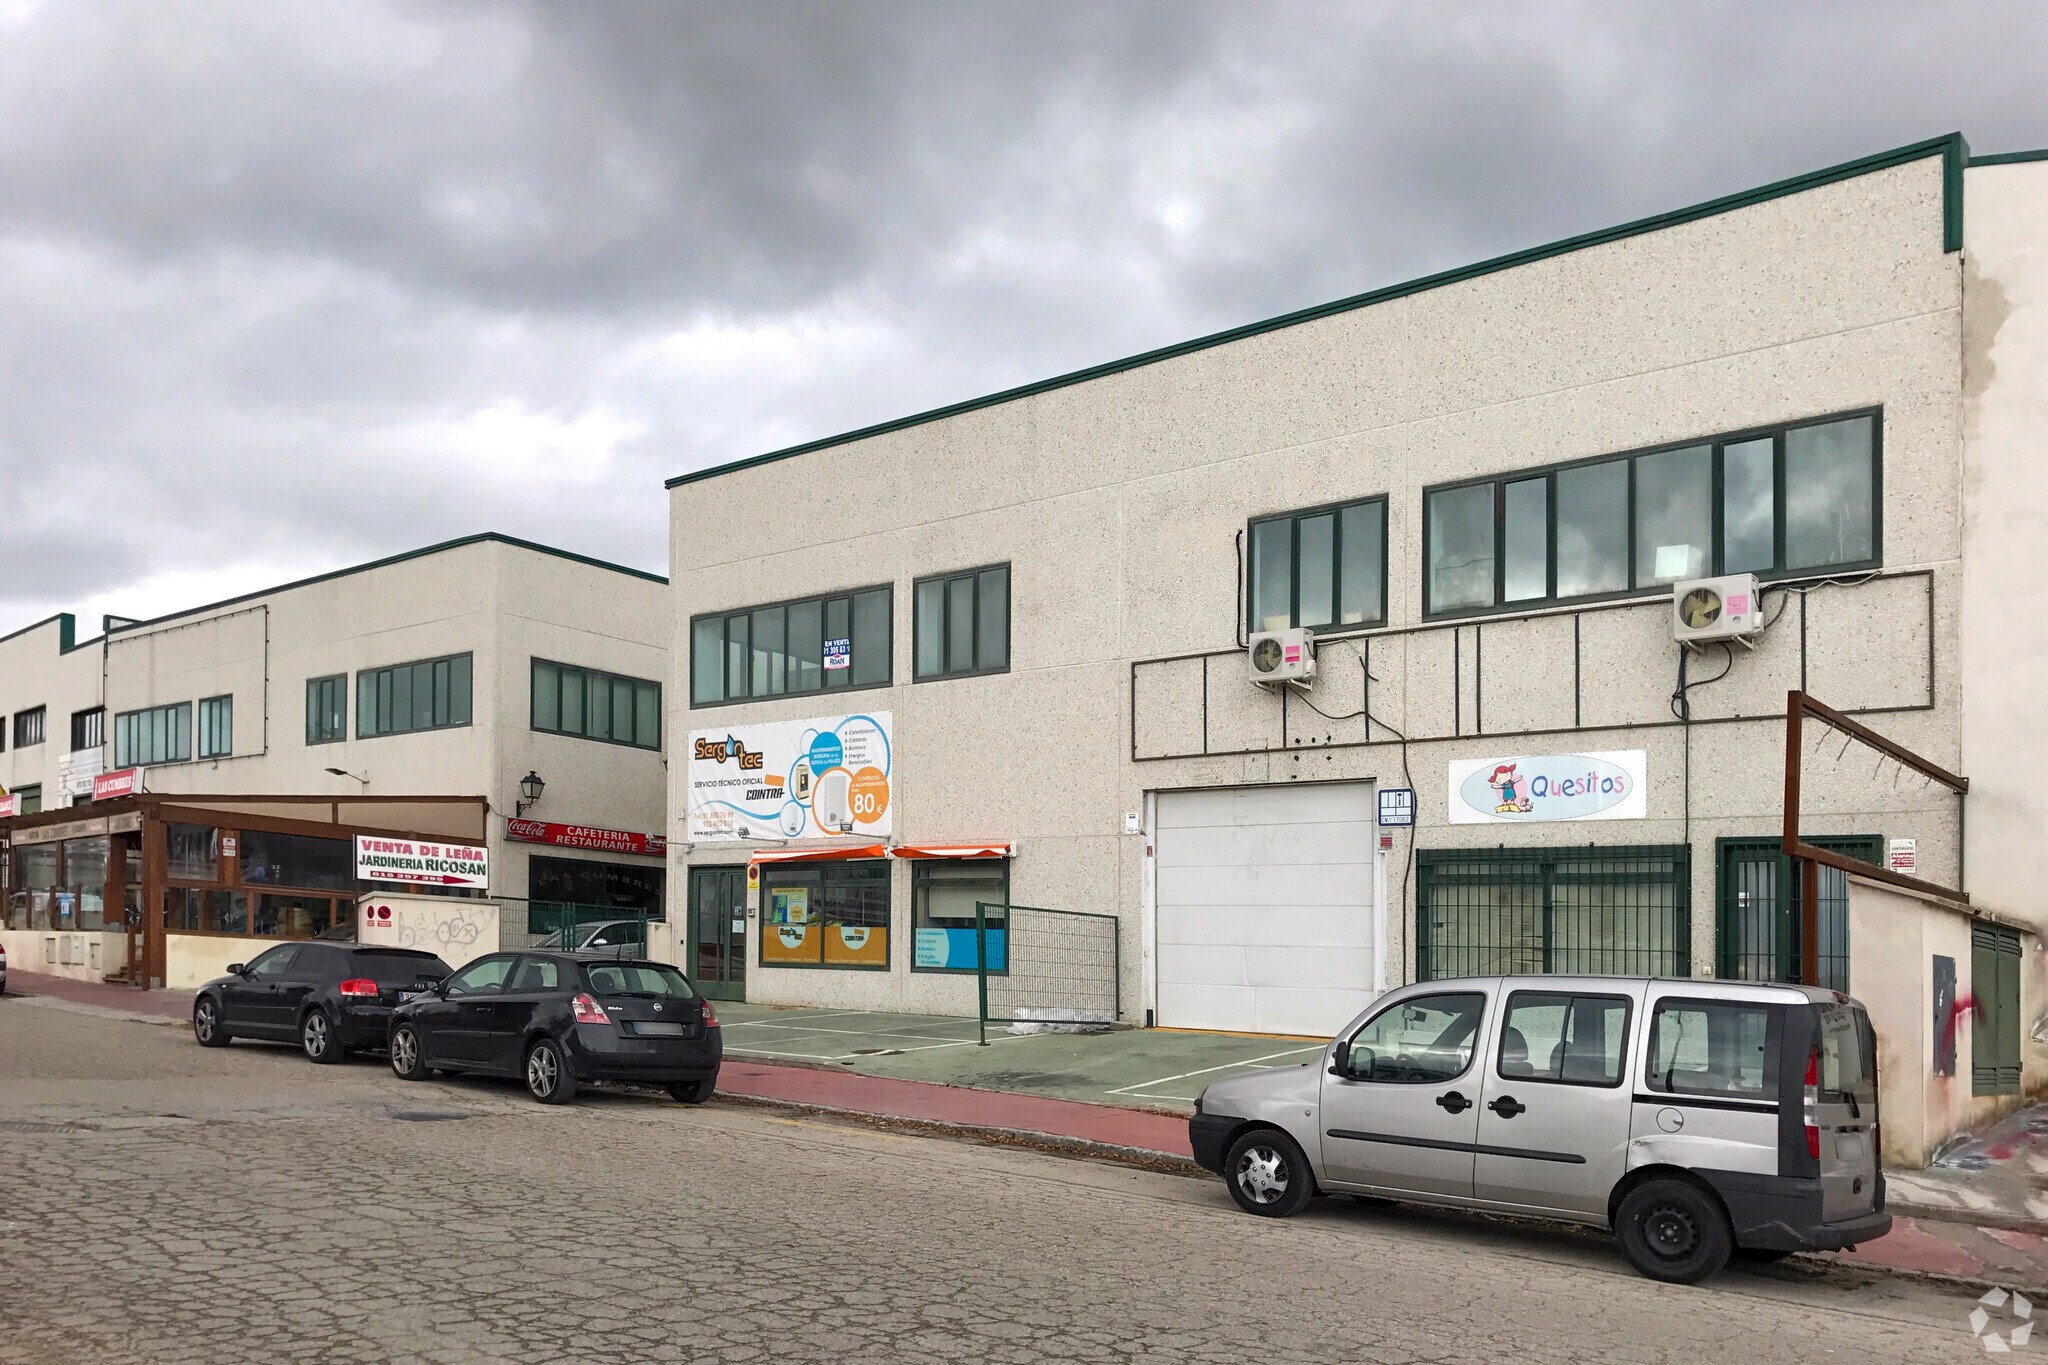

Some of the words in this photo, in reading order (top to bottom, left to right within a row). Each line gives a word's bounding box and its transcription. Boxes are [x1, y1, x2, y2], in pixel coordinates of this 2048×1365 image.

[97, 781, 108, 794] LAS
[694, 780, 718, 788] SERVICIO
[742, 777, 763, 786] OFICIAL
[1531, 771, 1625, 798] Quesitos
[854, 792, 875, 814] 80
[556, 835, 638, 851] RESTAURANTE
[566, 826, 630, 842] CAFETERIA
[361, 839, 413, 855] VENTA
[419, 845, 439, 857] DE
[445, 847, 484, 861] LEÑA
[359, 854, 423, 870] JARDINERIA
[425, 858, 486, 876] RICOSAN
